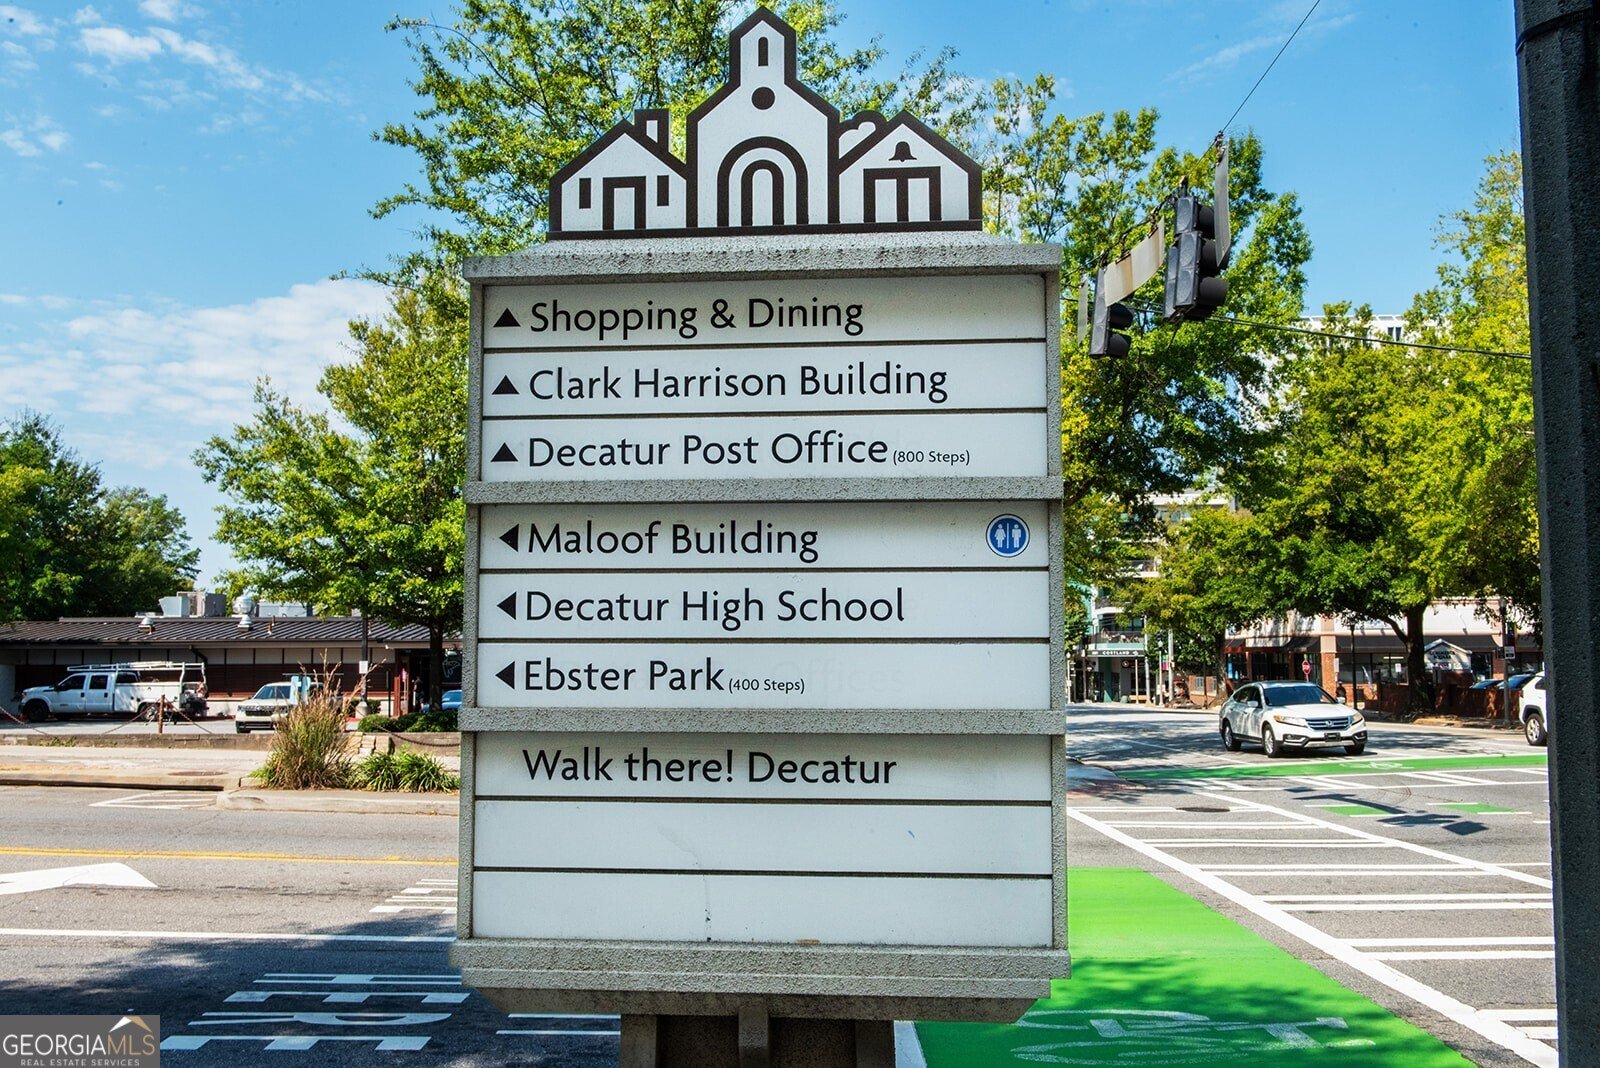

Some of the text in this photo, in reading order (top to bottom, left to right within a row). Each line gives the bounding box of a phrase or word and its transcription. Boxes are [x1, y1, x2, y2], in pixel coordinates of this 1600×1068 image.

[530, 297, 864, 341] Shopping & Dining
[530, 361, 948, 404] Clark Harrison Building
[530, 430, 970, 467] Decatur Post Office (800 Steps)
[528, 520, 818, 564] Maloof Building
[527, 588, 904, 632] Decatur High School
[526, 657, 805, 695] Ebster Park (400 Steps)
[522, 747, 897, 785] Walk there! Decatur
